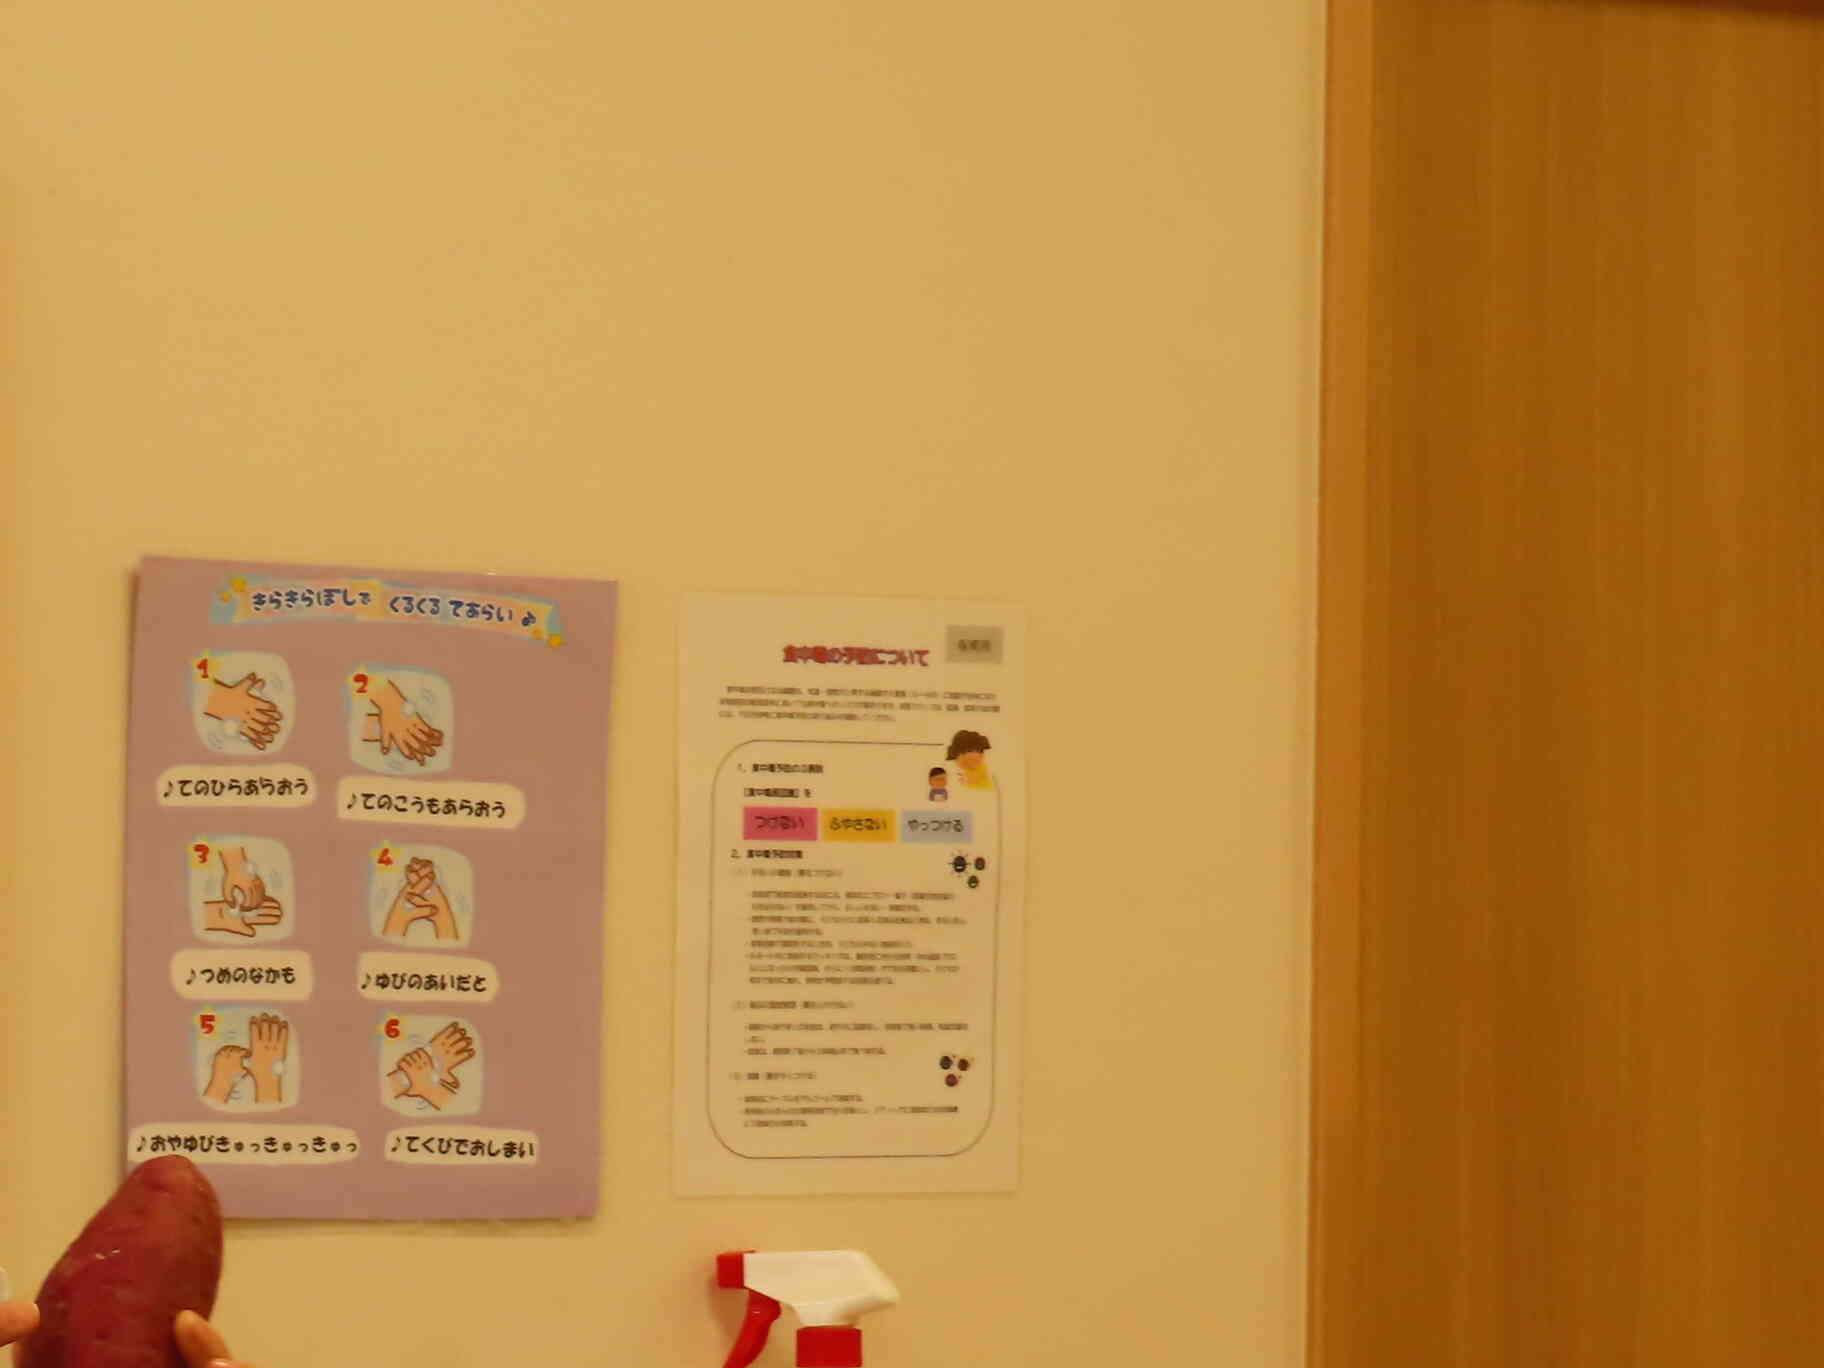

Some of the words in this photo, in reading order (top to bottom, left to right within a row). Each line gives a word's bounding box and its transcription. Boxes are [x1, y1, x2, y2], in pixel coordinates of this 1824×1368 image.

[388, 596, 441, 615] くるくる
[448, 599, 513, 622] てあらい
[196, 658, 209, 679] 1
[353, 673, 369, 693] 2
[178, 776, 309, 798] てのひらあらおう
[361, 792, 506, 818] てのこうもあらおう
[829, 817, 887, 832] ふやさない
[907, 818, 964, 833] やっつける
[193, 843, 210, 864] 3
[376, 847, 393, 866] 4
[200, 966, 296, 985] つめのなかも
[375, 972, 487, 992] ゆびのあいだと
[198, 1013, 216, 1035] 5
[384, 1018, 401, 1039] 6
[150, 1135, 358, 1153] おやゆびきゅっきゅっきゅっ
[405, 1135, 534, 1158] てくびでおしまい
